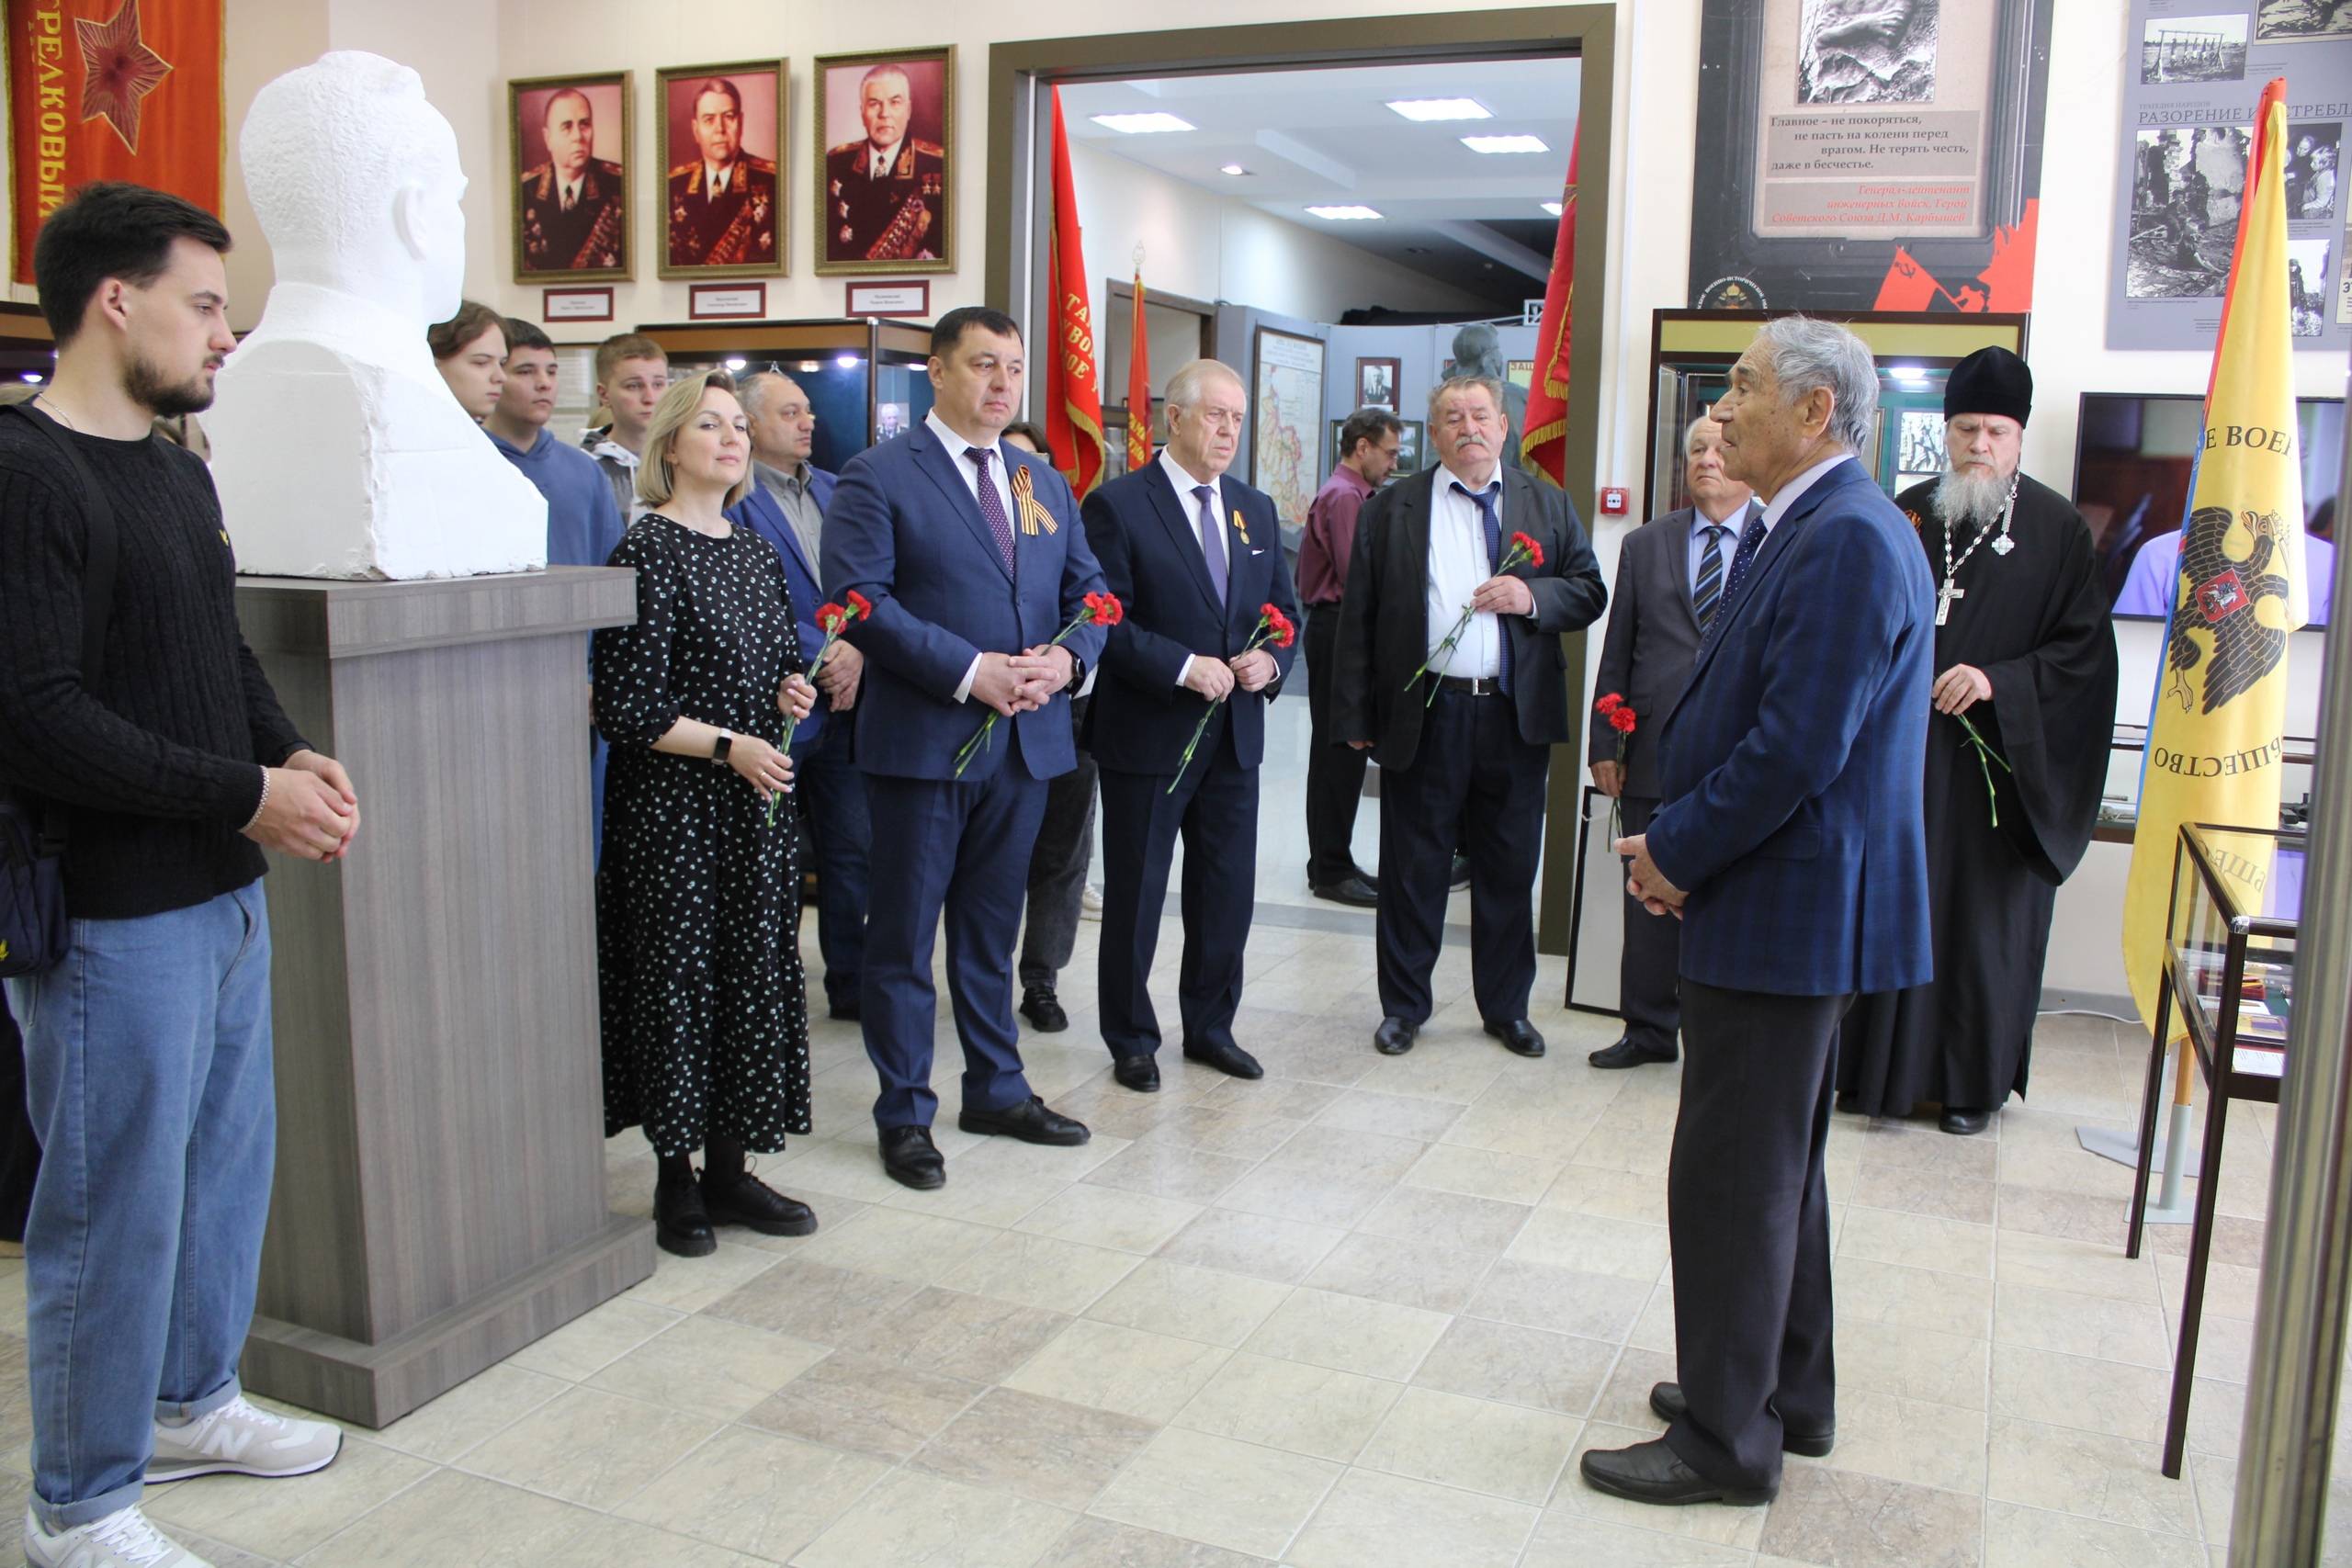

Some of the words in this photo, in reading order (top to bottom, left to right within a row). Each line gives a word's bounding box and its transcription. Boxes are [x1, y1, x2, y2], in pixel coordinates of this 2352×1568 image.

[2139, 107, 2242, 123] РАЗОРЕНИЕ
[2287, 103, 2352, 118] ТРЕБЛ
[1770, 117, 1818, 127] Главное
[1831, 117, 1845, 125] не
[1849, 116, 1922, 127] покоряться,
[1794, 132, 1808, 141] не
[1812, 131, 1843, 141] пасть
[1847, 131, 1860, 140] на
[1864, 130, 1909, 140] колени
[1913, 130, 1949, 141] перед
[1821, 147, 1866, 156] врагом.
[1869, 144, 1884, 154] Не
[1889, 146, 1929, 155] терять
[1933, 144, 1969, 154] честь,
[1771, 162, 1801, 171] даже
[1814, 159, 1873, 169] бесчестье.
[1935, 198, 1968, 209] Герой
[1771, 212, 1837, 223] Советского
